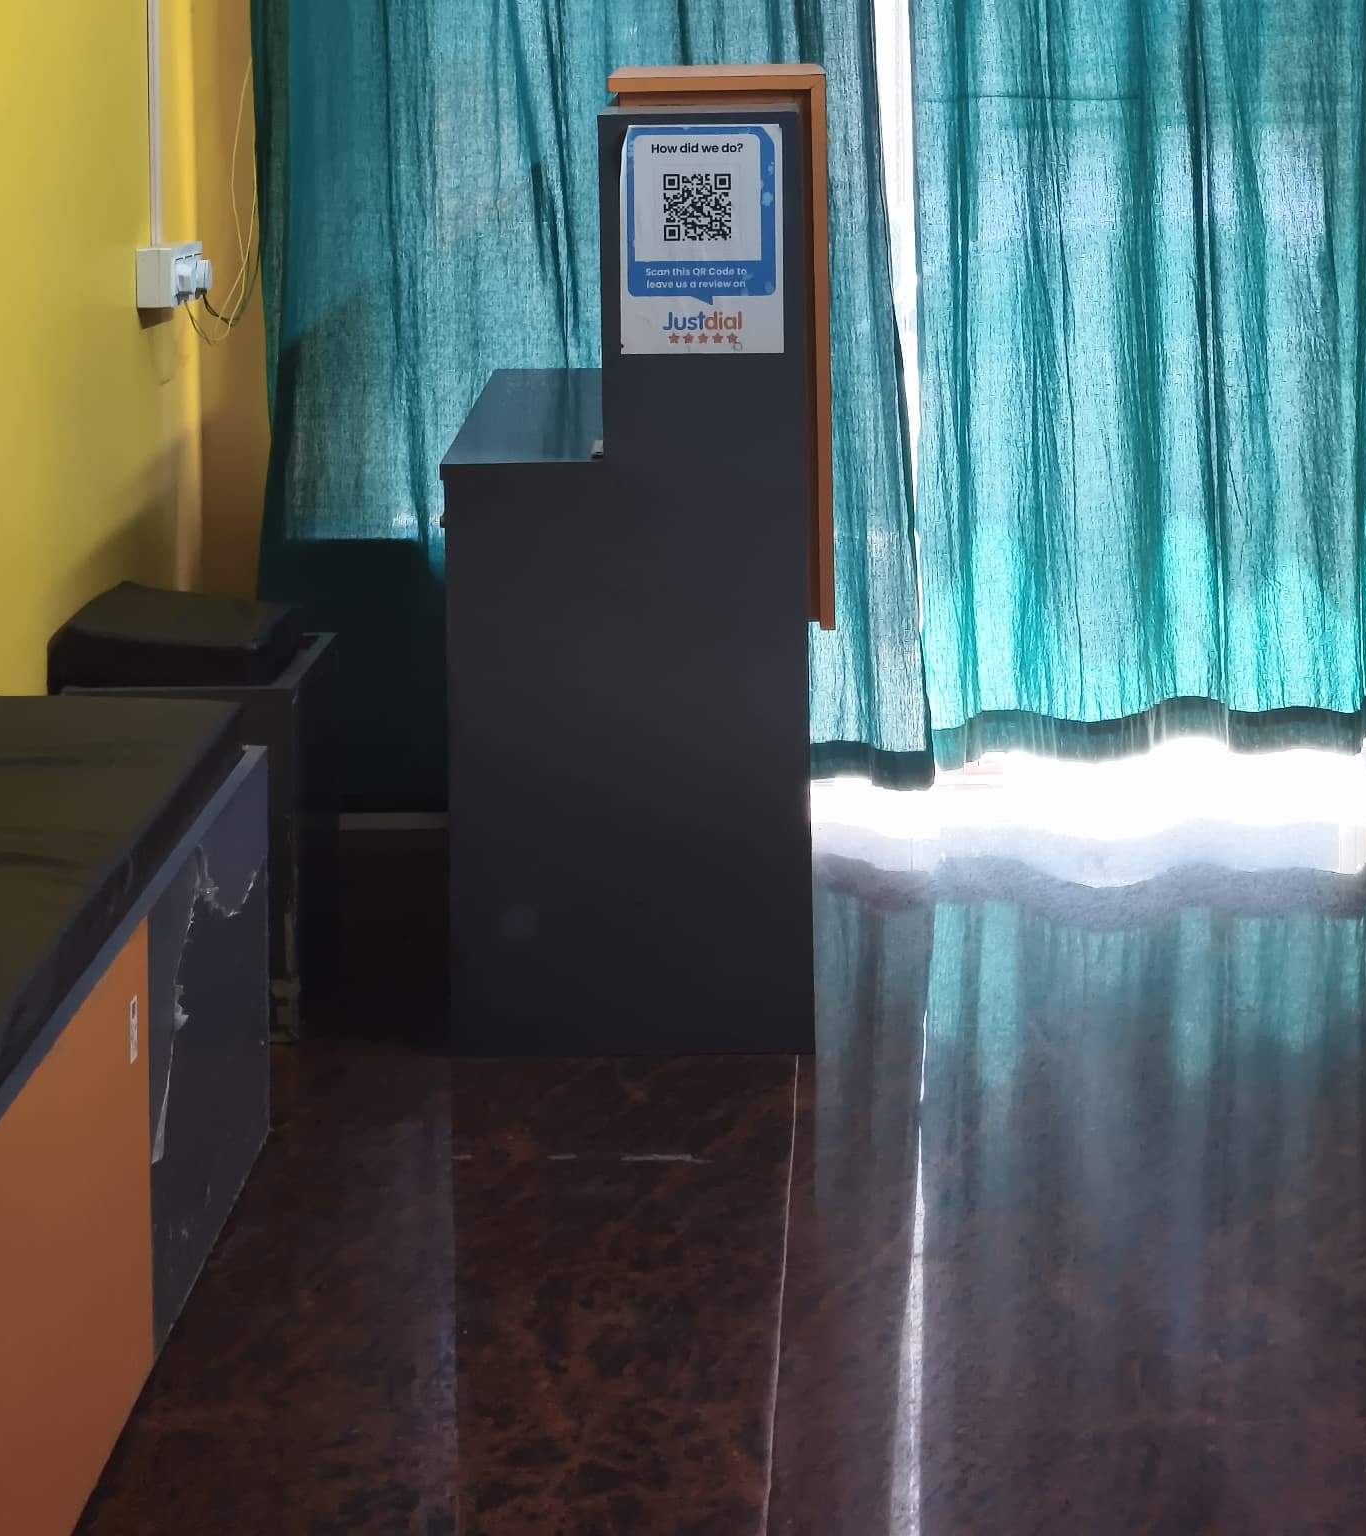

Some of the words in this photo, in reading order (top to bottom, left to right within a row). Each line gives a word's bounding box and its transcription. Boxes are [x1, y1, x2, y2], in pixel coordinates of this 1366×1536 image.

[651, 144, 677, 153] How
[679, 143, 699, 153] did
[701, 145, 719, 153] we
[721, 143, 743, 153] do?
[645, 268, 670, 277] Scan
[672, 267, 690, 277] this
[693, 268, 706, 277] QR
[708, 267, 735, 277] Code
[737, 268, 747, 277] to
[646, 280, 673, 289] leave
[675, 281, 688, 289] us
[690, 281, 696, 289] a
[698, 279, 730, 289] review
[733, 281, 746, 289] on
[662, 311, 743, 331] Justdial
